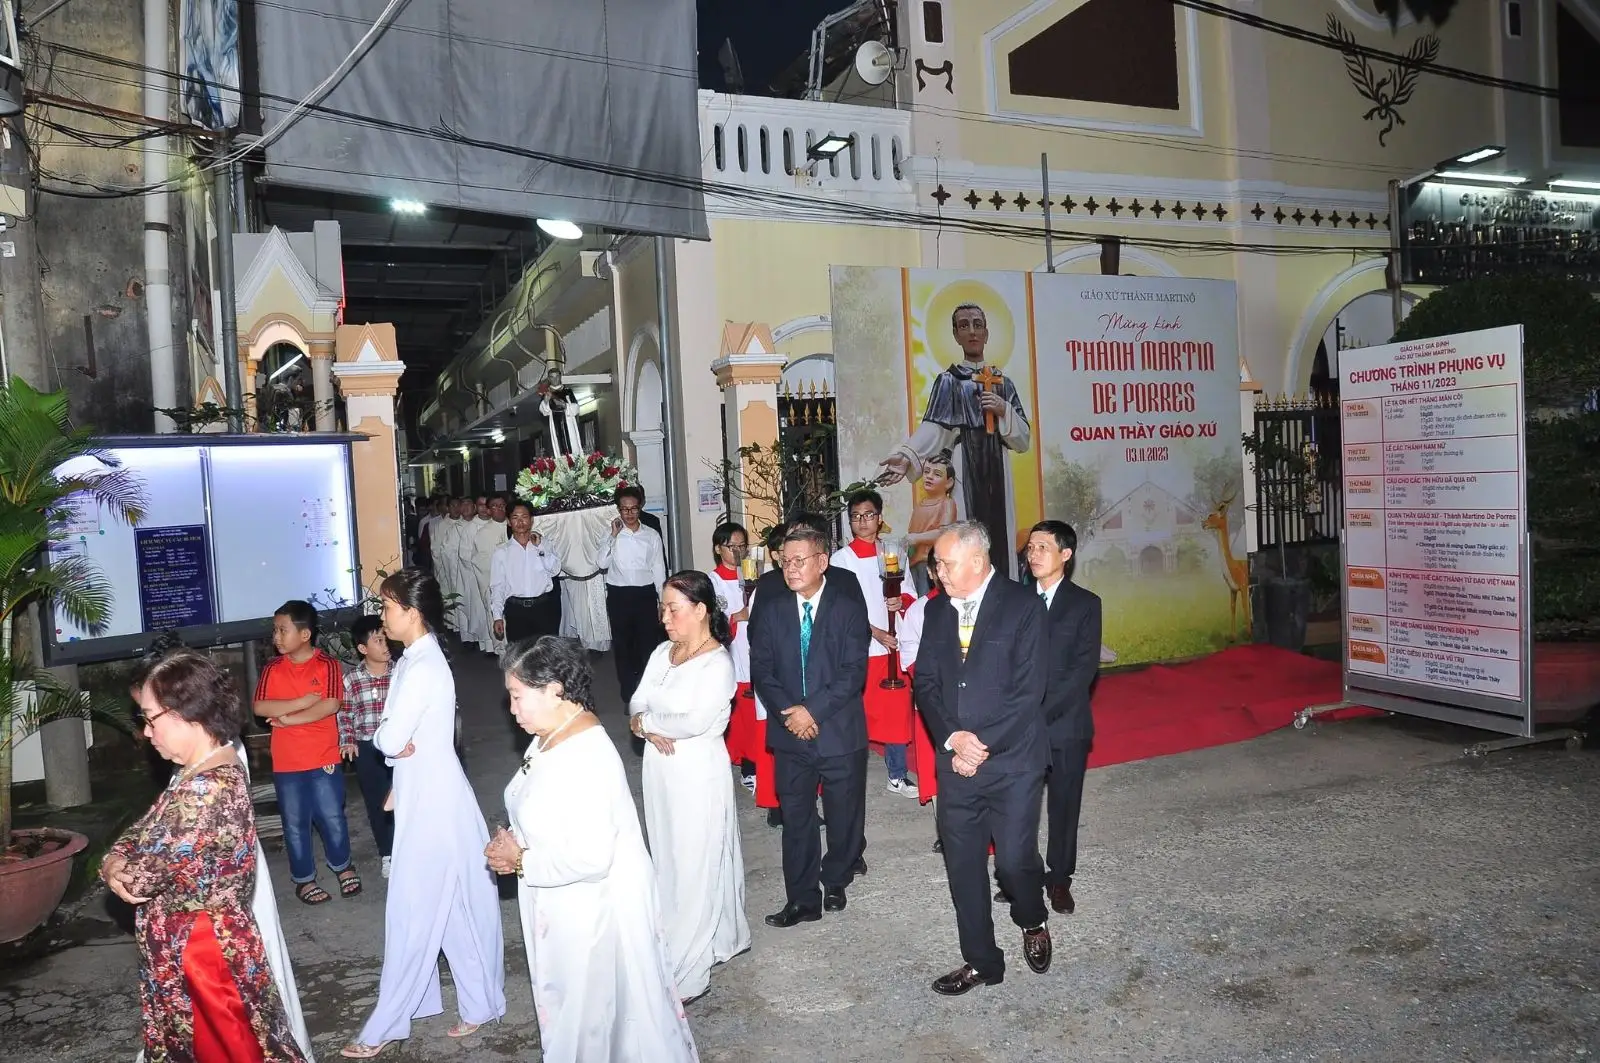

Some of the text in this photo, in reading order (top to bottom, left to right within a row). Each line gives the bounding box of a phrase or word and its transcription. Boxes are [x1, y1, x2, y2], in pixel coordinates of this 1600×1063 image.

[1080, 288, 1103, 300] GIÁO
[1105, 288, 1120, 300] XỨ
[1120, 290, 1154, 300] THÁNH
[1153, 315, 1182, 330] kính
[1066, 334, 1215, 372] THÁNH MARTIN
[1350, 354, 1506, 384] CHƯƠNG TRÌNH PHỤNG VỤ
[1391, 377, 1456, 392] THÁNG 11/2023
[1092, 382, 1196, 414] DE PORRES
[1070, 420, 1217, 442] QUAN THẦY GIÁO XỨ
[1126, 448, 1168, 462] 03.11.2023
